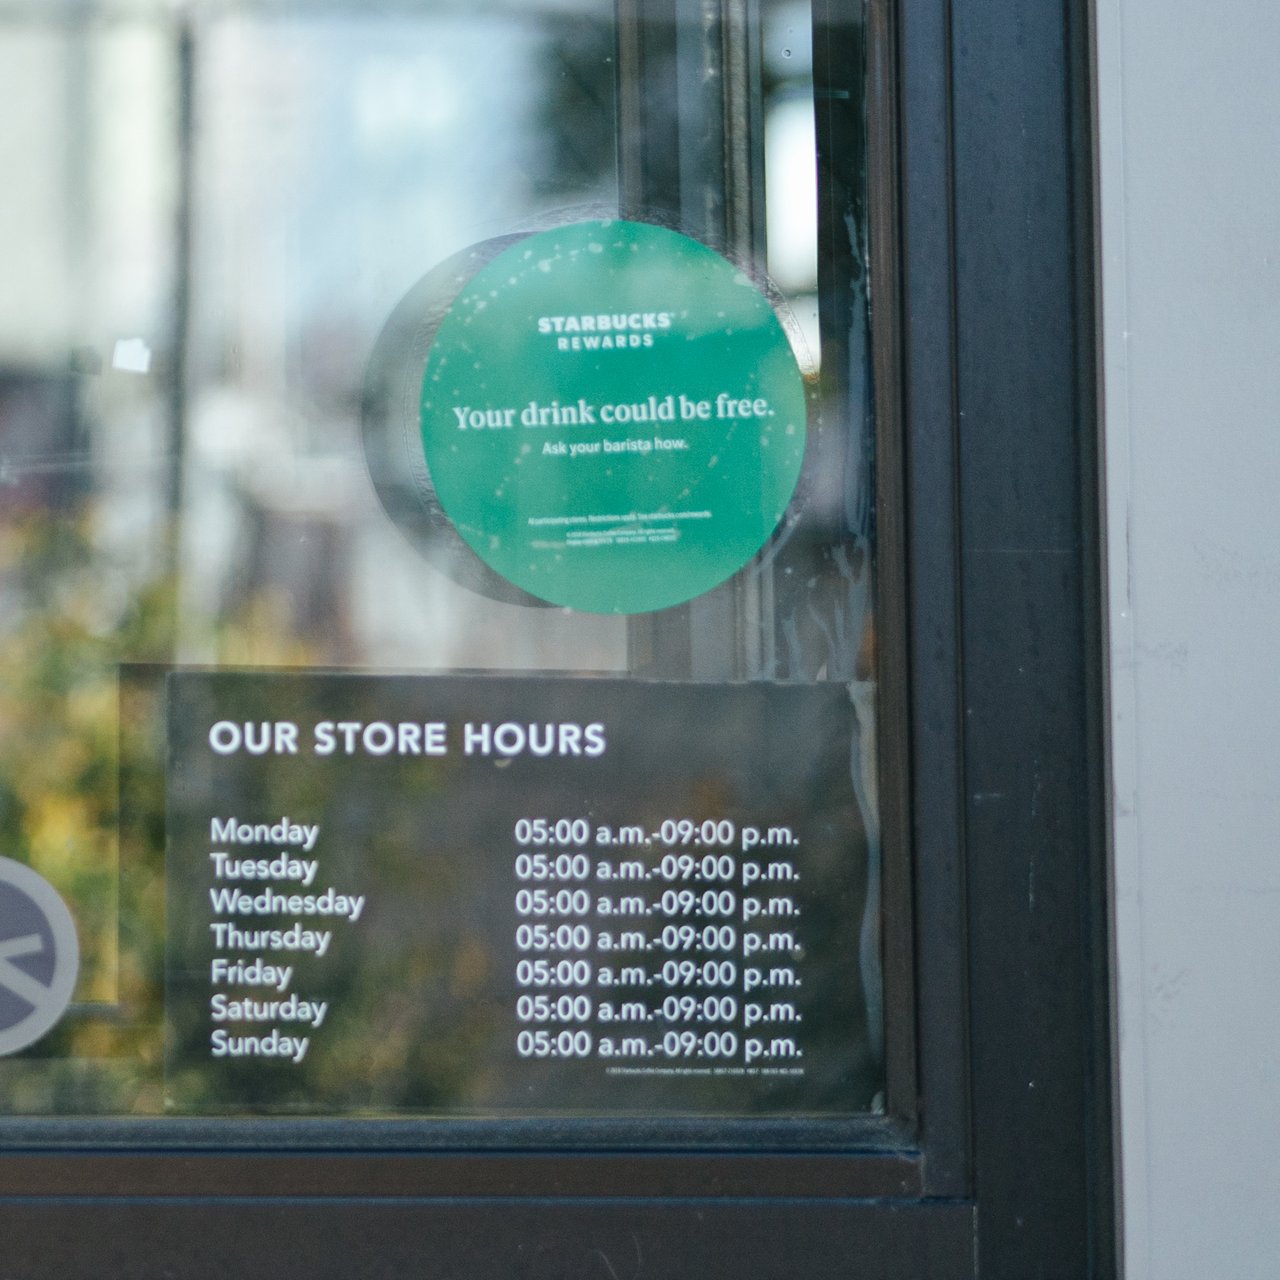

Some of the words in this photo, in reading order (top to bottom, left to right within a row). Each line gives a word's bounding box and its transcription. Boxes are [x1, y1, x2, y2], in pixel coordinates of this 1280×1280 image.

[538, 312, 671, 333] STARBUCKS
[557, 333, 654, 351] REWARDS
[452, 406, 516, 430] Your
[520, 399, 596, 427] drink
[600, 394, 675, 423] could
[678, 394, 711, 419] be
[715, 392, 775, 418] free.
[542, 441, 567, 455] Ask
[569, 442, 600, 457] your
[603, 438, 652, 452] barista
[654, 436, 689, 450] how.
[208, 720, 299, 755] OUR
[313, 721, 448, 755] STORE
[464, 722, 606, 756] HOURS
[210, 816, 320, 852] Monday
[515, 819, 589, 845] 05:00
[742, 826, 800, 851] p.m.
[209, 851, 319, 887] Tuesday
[515, 854, 589, 880] 05:00
[742, 862, 800, 886] p.m.
[209, 886, 366, 922] Wednesday
[516, 890, 590, 916] 05:00
[743, 897, 801, 922] p.m.
[209, 921, 332, 957] Thursday
[516, 926, 590, 952] 05:00
[743, 932, 801, 958] p.m.
[211, 957, 293, 992] Friday
[516, 961, 590, 987] 05:00
[743, 968, 801, 993] p.m.
[210, 992, 328, 1028] Saturday
[517, 996, 591, 1022] 05:00
[744, 1004, 802, 1028] p.m.
[211, 1028, 310, 1063] Sunday
[517, 1032, 591, 1058] 05:00
[744, 1039, 802, 1064] p.m.
